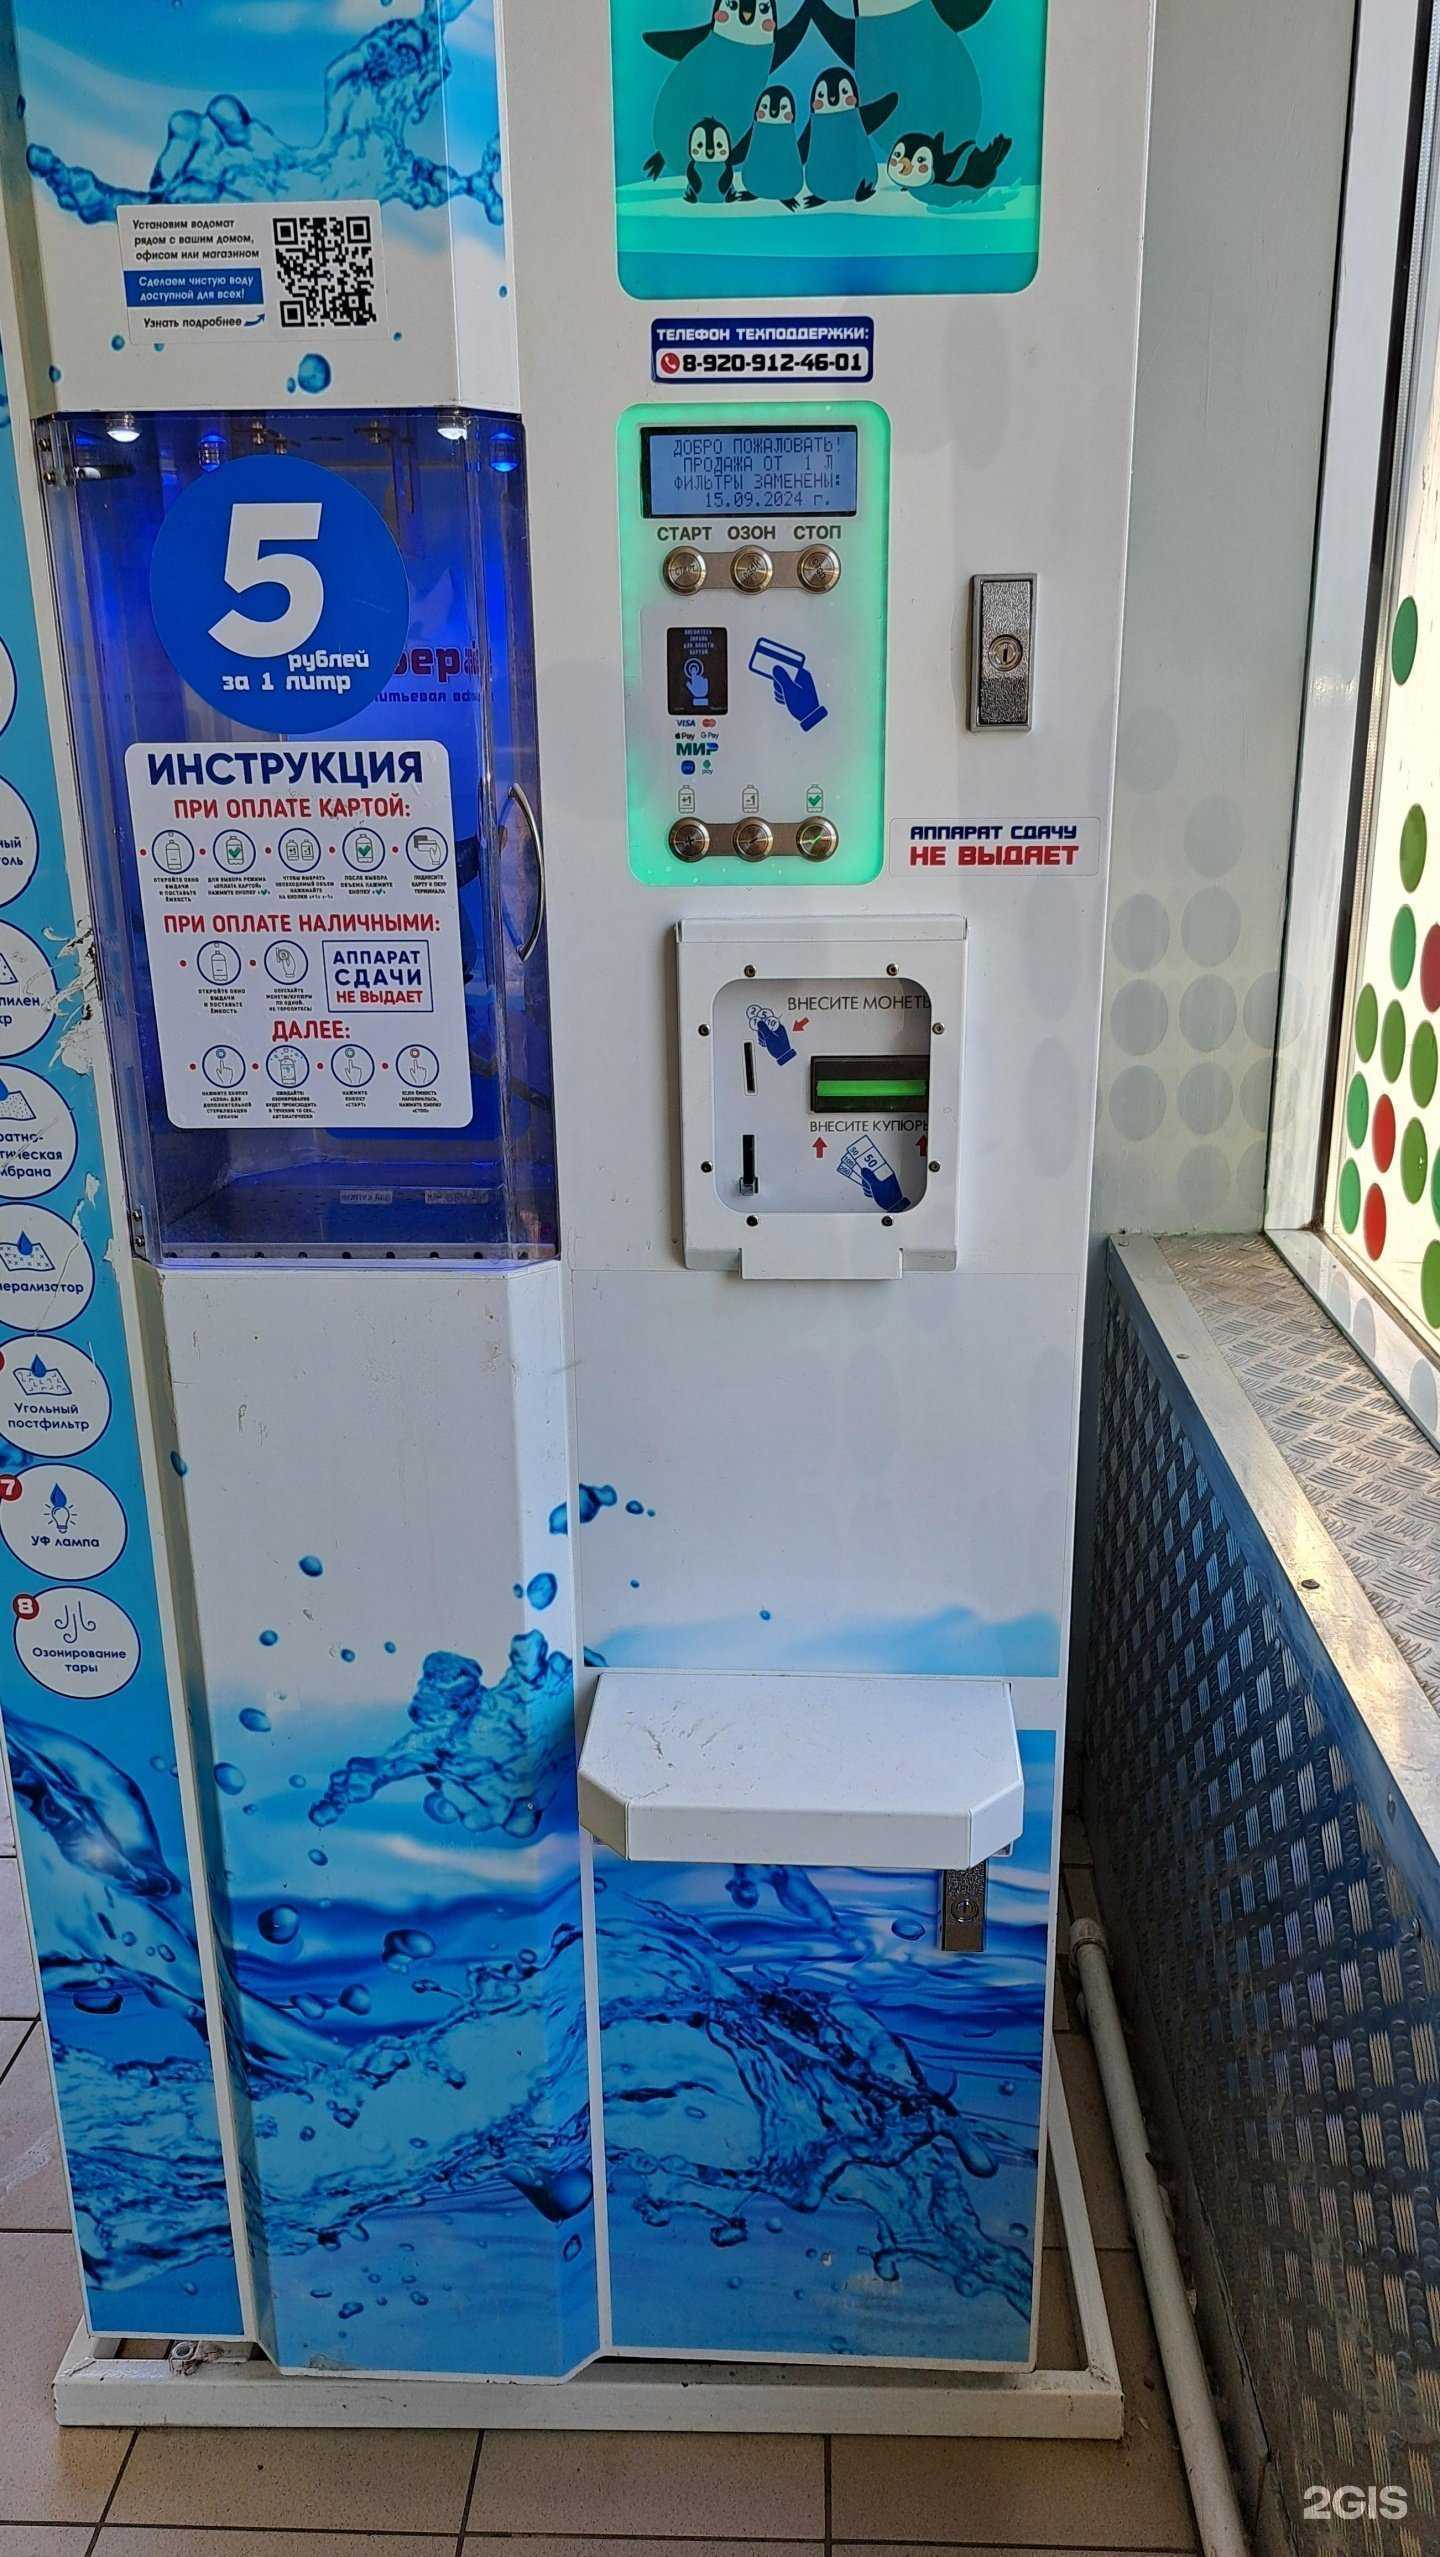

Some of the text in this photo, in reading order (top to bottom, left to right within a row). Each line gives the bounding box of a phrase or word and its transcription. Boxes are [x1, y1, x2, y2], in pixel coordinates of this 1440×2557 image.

[133, 219, 234, 230] Установим водомат
[134, 235, 254, 247] рядом с вашим домом,
[135, 249, 259, 262] офисом или магазином
[138, 276, 254, 288] Сделаем чистую воду
[140, 289, 245, 302] доступной для всех!
[143, 316, 242, 330] Узнать подробнее
[656, 327, 870, 341] ТЕЛЕФОН ТЕХПОДДЕРЖКИ:
[682, 352, 863, 373] 8-920-912-46-01
[673, 437, 842, 457] ДОБРО ПОЖАЛОВАТЬ!
[683, 455, 834, 475] ПРОДАЖА ОТ 1 Л
[673, 473, 841, 491] ФИЛЬТРЫ ЗАМЕНЕНЫ:
[704, 491, 803, 508] 15.09.2024
[657, 525, 842, 542] СТАРТ ОЗОН СТОП
[207, 501, 325, 658] 5
[288, 649, 370, 672] рублей
[223, 671, 351, 695] за 1 литр
[677, 719, 696, 728] VISA
[676, 742, 719, 756] МИР
[147, 750, 424, 789] ИНСТРУКЦИЯ
[173, 793, 411, 820] ПРИ ОПЛАТЕ КАРТОЙ:
[910, 825, 1078, 841] АППАРАТ СДАЧУ
[909, 845, 1080, 867] НЕ ВЫДАЕТ
[163, 913, 441, 933] ПРИ ОПЛАТЕ НАЛИЧНЫМИ:
[333, 949, 421, 965] АППАРАТ
[334, 968, 422, 989] СДАЧИ
[336, 990, 424, 1005] НЕ ВЫДАЕТ
[787, 996, 859, 1012] ВНЕСИТЕ
[272, 1020, 351, 1042] ДАЛЕЕ:
[809, 1120, 869, 1133] ВНЕСИТЕ
[863, 1153, 878, 1168] 50
[14, 1402, 79, 1415] Угольный
[8, 1418, 90, 1432] постфильтр
[1, 1479, 15, 1496] 7
[31, 1535, 100, 1549] УФ лампа
[17, 1600, 34, 1615] 8
[32, 1647, 127, 1660] Озонирование
[64, 1663, 99, 1674] тары
